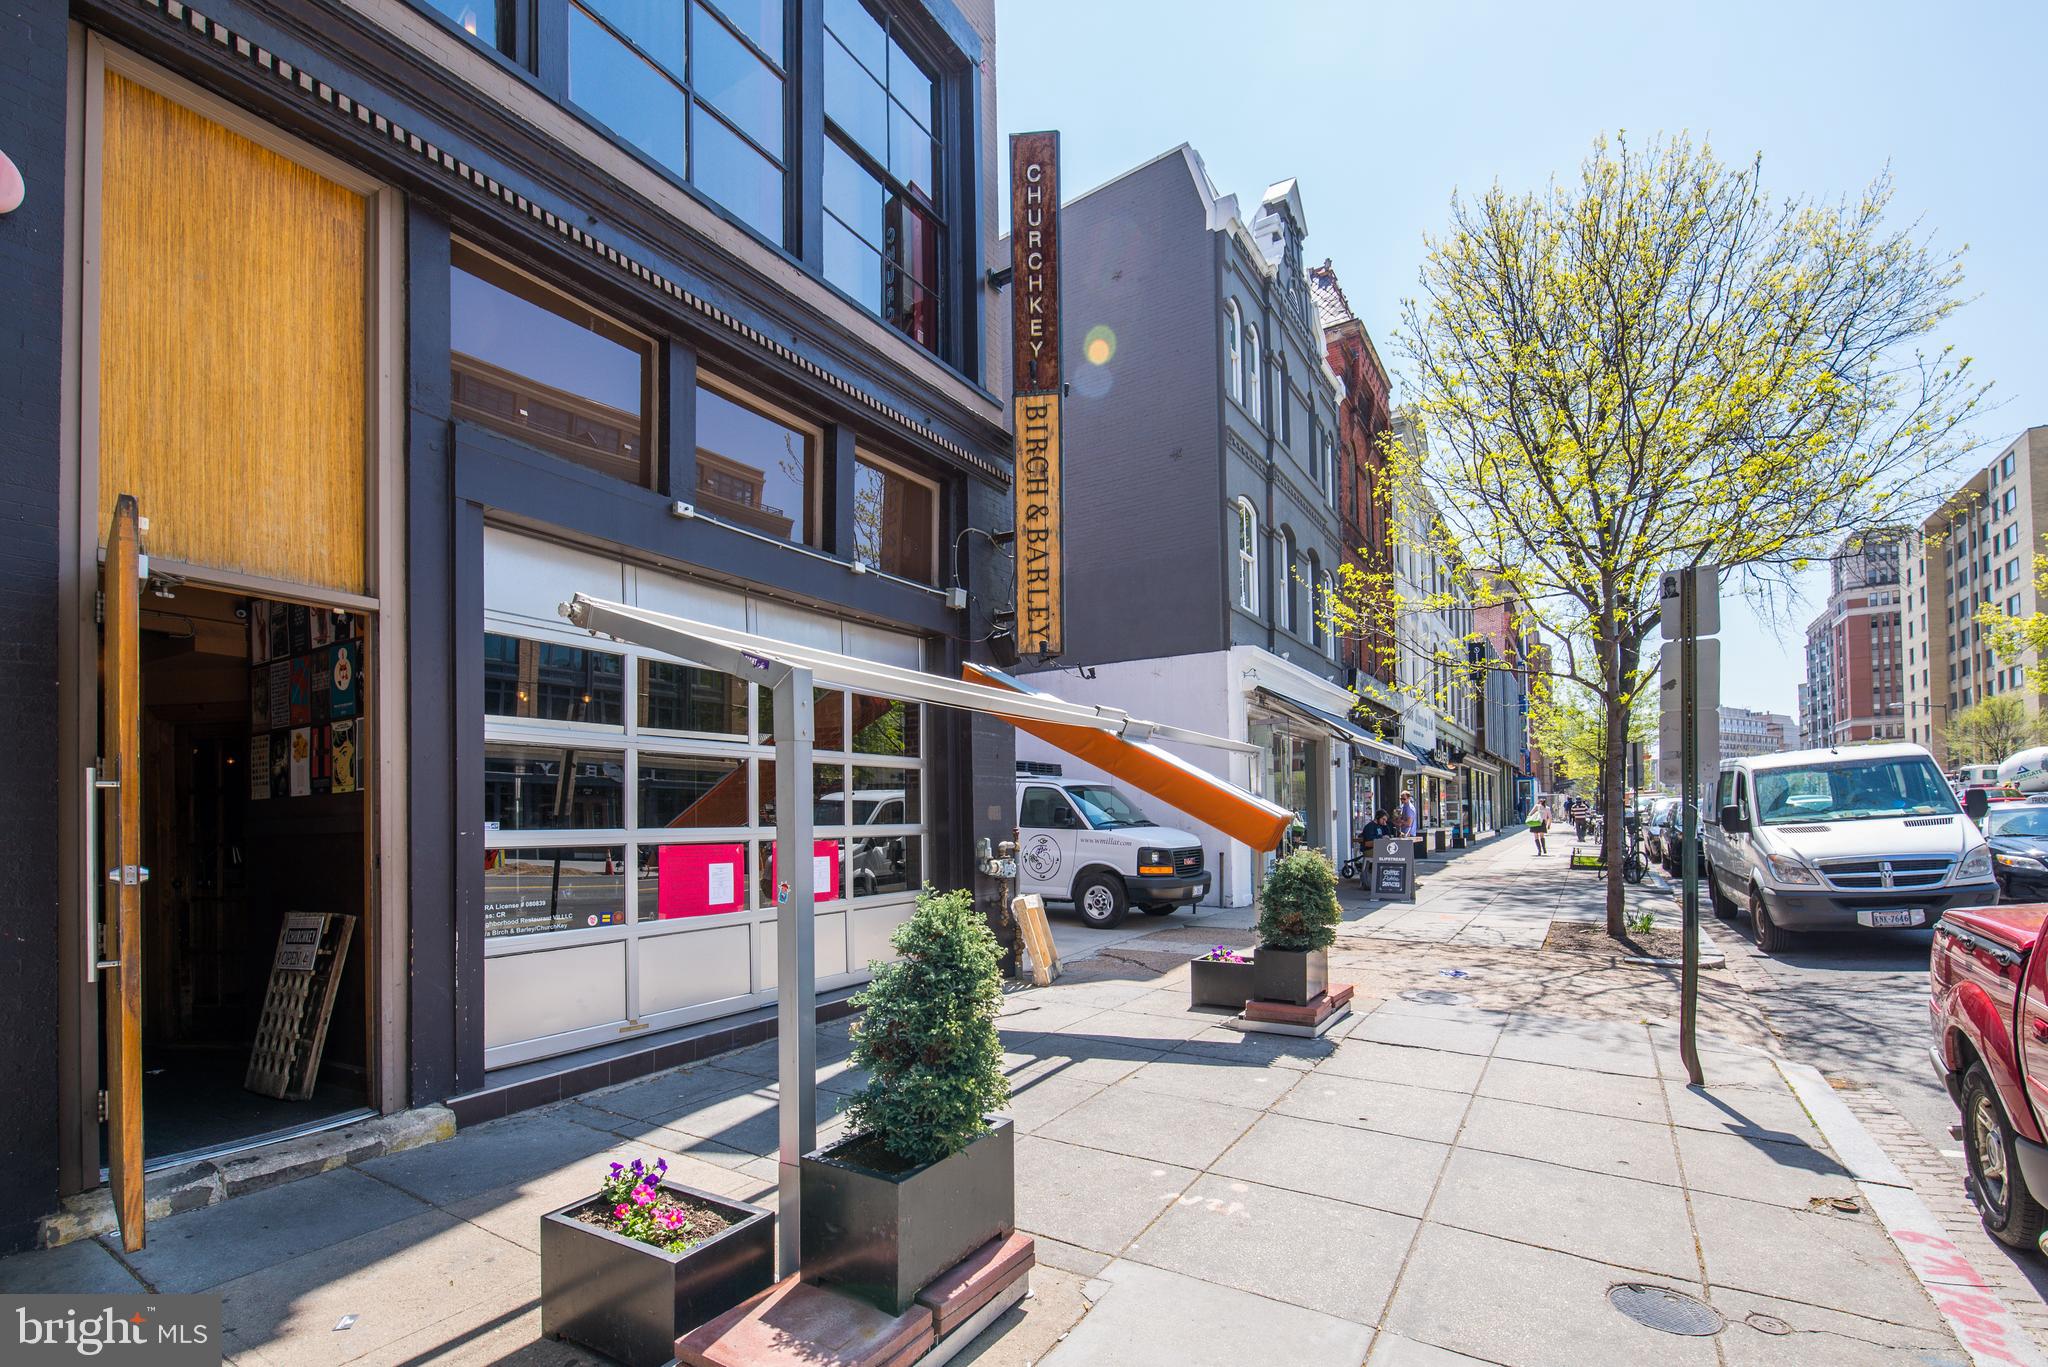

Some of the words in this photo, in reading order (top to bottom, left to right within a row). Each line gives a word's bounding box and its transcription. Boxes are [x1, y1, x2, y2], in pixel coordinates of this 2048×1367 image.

[1026, 164, 1044, 358] CHURCHKEY
[1025, 403, 1049, 496] BIRCH
[1026, 504, 1050, 523] &
[1027, 526, 1050, 642] BARLEY
